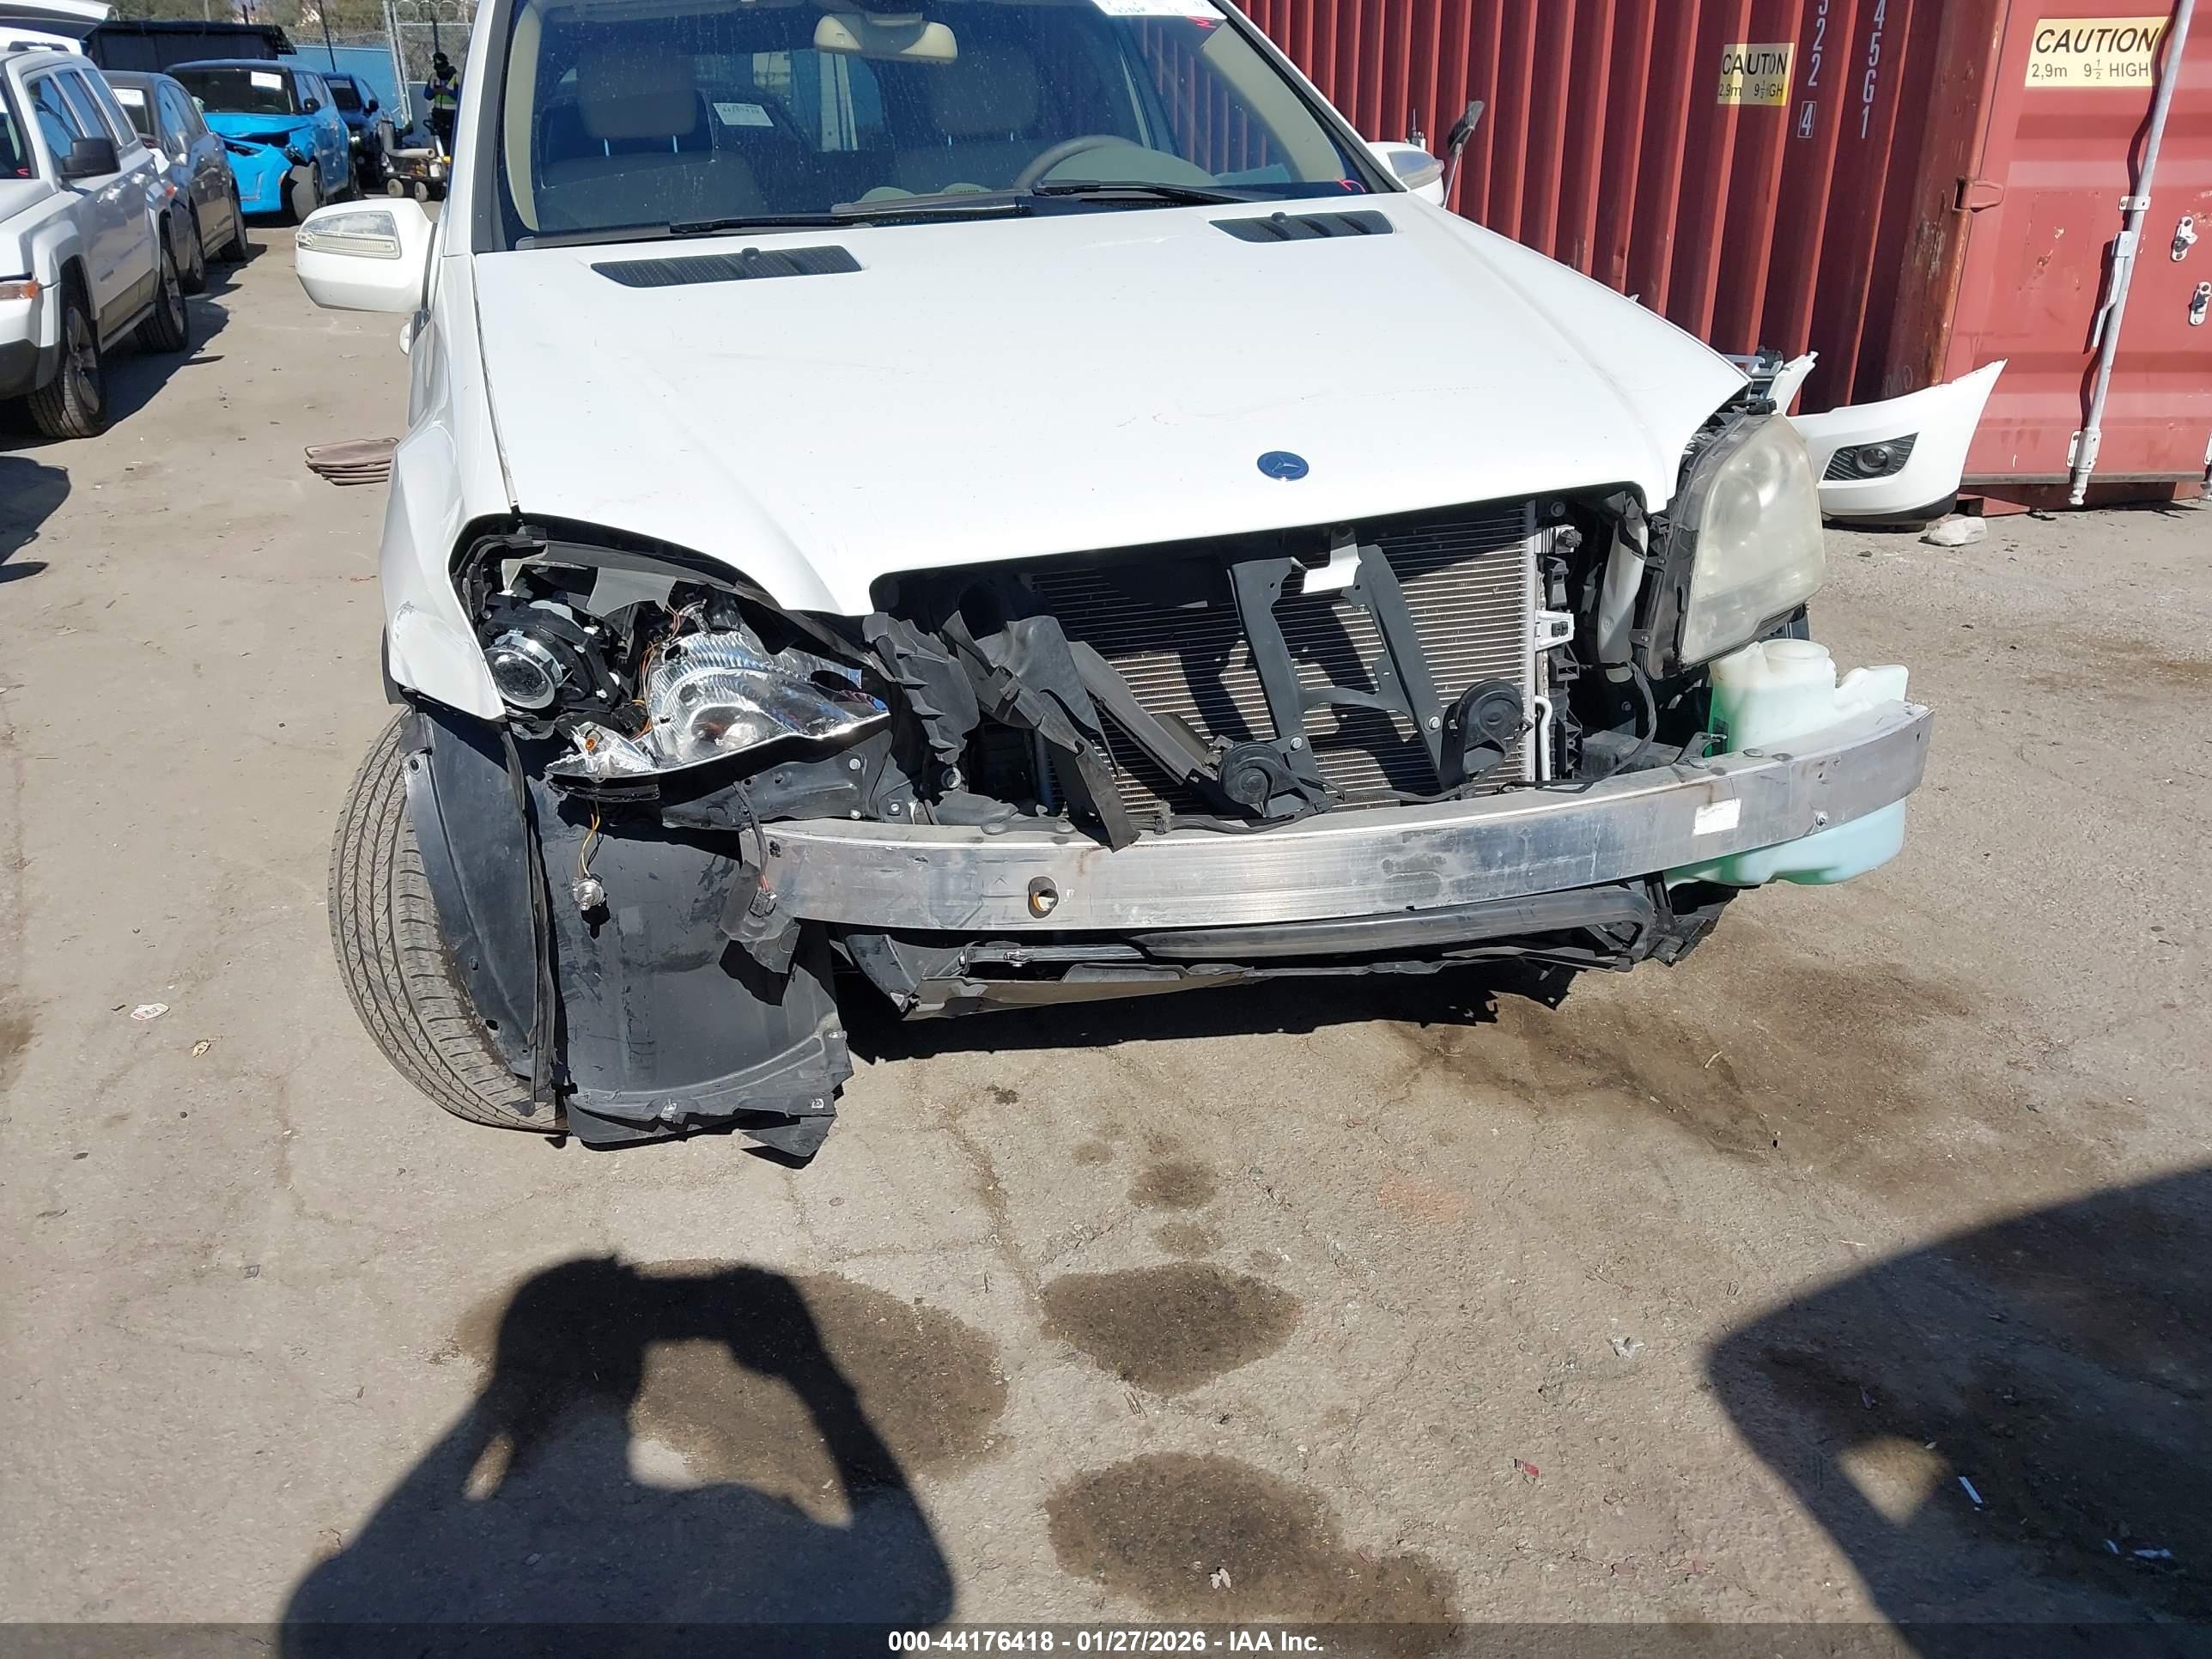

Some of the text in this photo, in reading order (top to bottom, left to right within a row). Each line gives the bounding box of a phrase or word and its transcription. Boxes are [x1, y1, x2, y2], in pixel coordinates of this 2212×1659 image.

[2035, 27, 2159, 53] CAUTION
[2031, 63, 2068, 80] 2,9m
[2109, 63, 2148, 76] HIGH
[1802, 103, 1813, 136] 4
